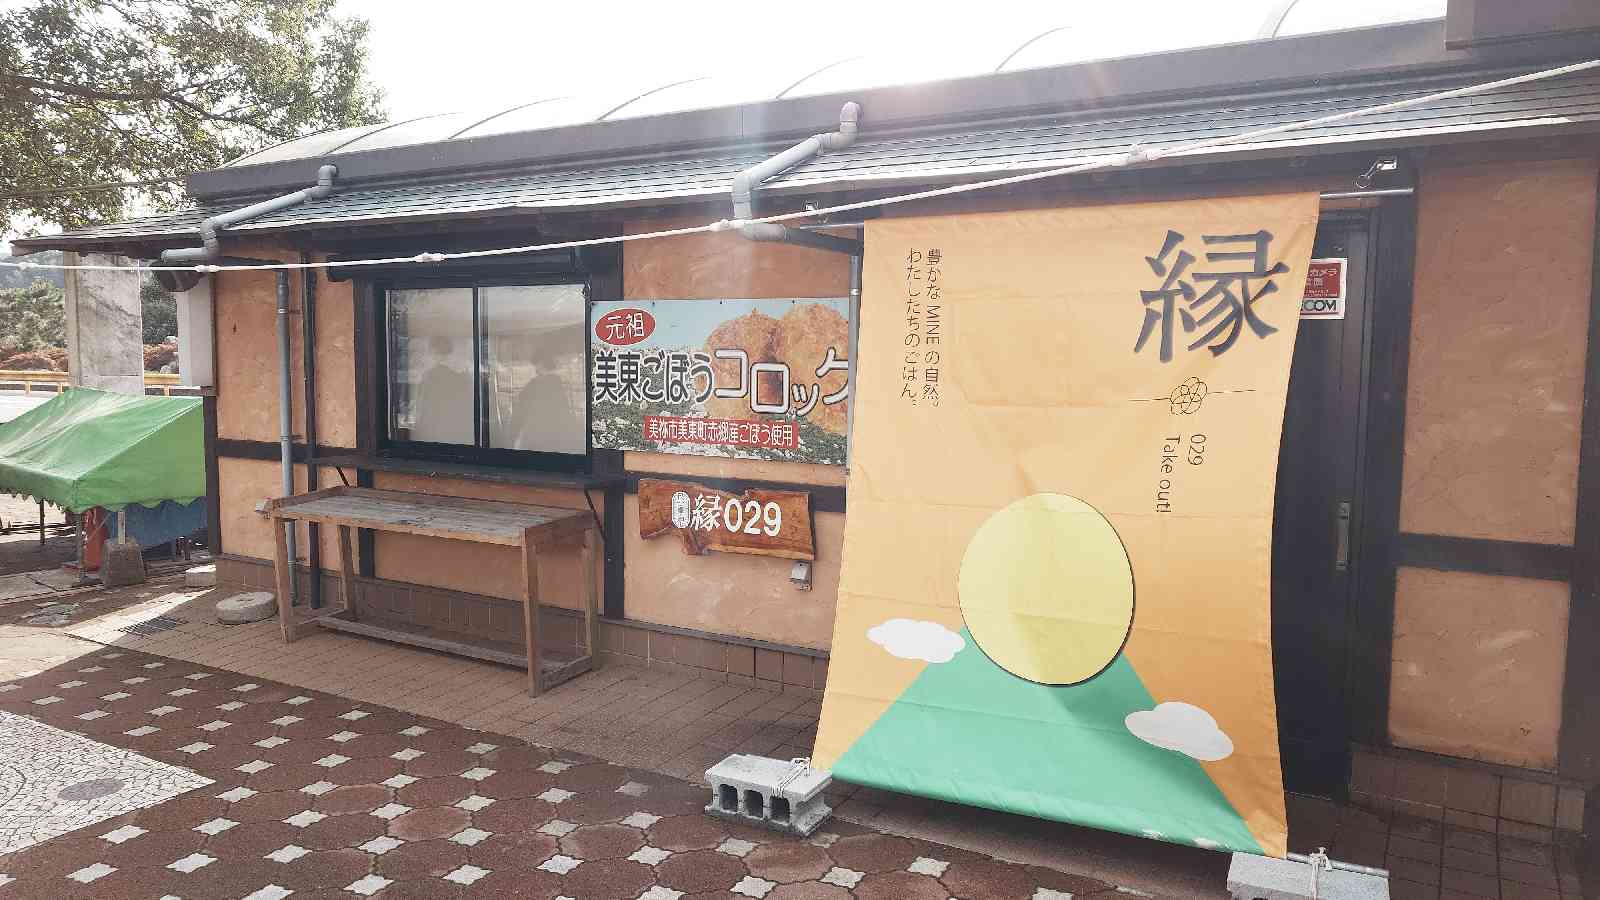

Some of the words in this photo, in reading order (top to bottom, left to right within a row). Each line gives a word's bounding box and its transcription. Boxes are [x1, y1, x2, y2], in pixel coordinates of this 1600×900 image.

[926, 248, 942, 300] 豊かな
[1134, 229, 1290, 363] 縁
[1301, 299, 1337, 312] COM
[605, 312, 645, 340] 元祖
[926, 305, 941, 345] MINE
[1161, 435, 1181, 474] Take
[1188, 433, 1206, 466] 029
[1156, 479, 1172, 513] out!
